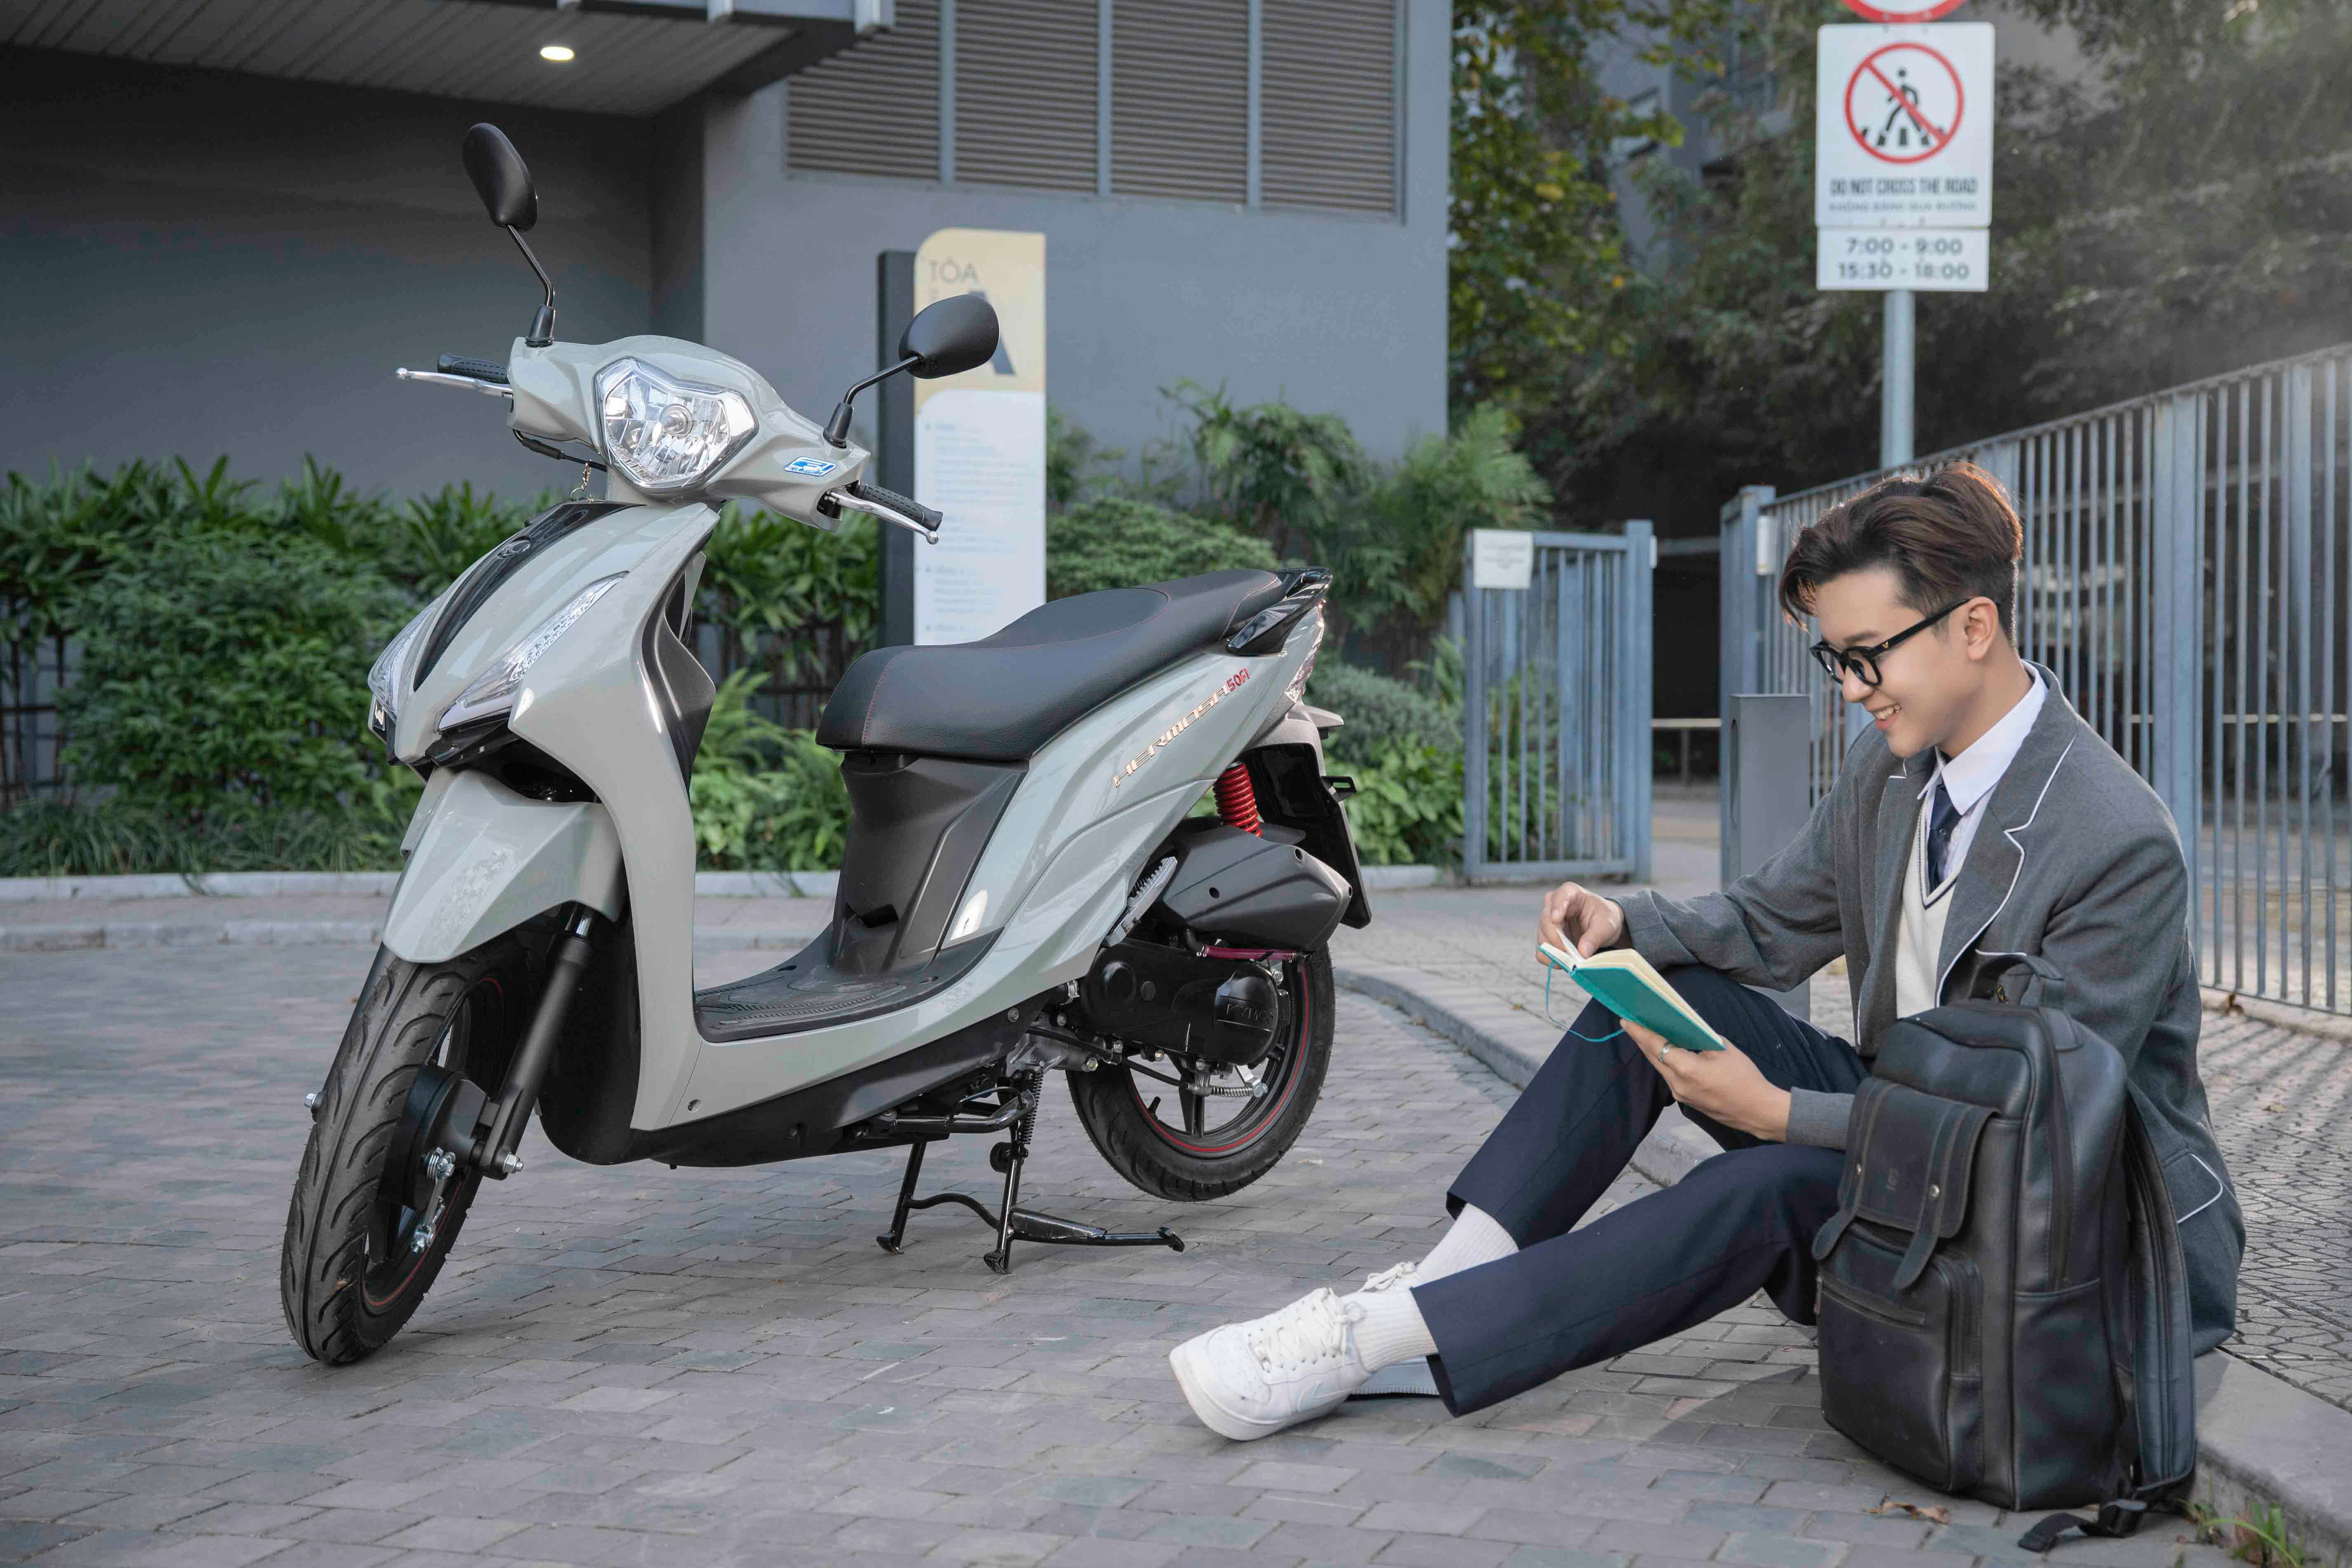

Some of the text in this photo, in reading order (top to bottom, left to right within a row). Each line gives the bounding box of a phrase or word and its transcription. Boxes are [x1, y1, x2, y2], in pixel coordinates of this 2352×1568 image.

[1830, 178, 1978, 196] DO NOT CROSS THE ROAD
[1846, 237, 1894, 255] 7:00
[1915, 237, 1963, 256] 9:00
[1838, 261, 1893, 280] 15:30
[1112, 685, 1229, 788] HERMOSA
